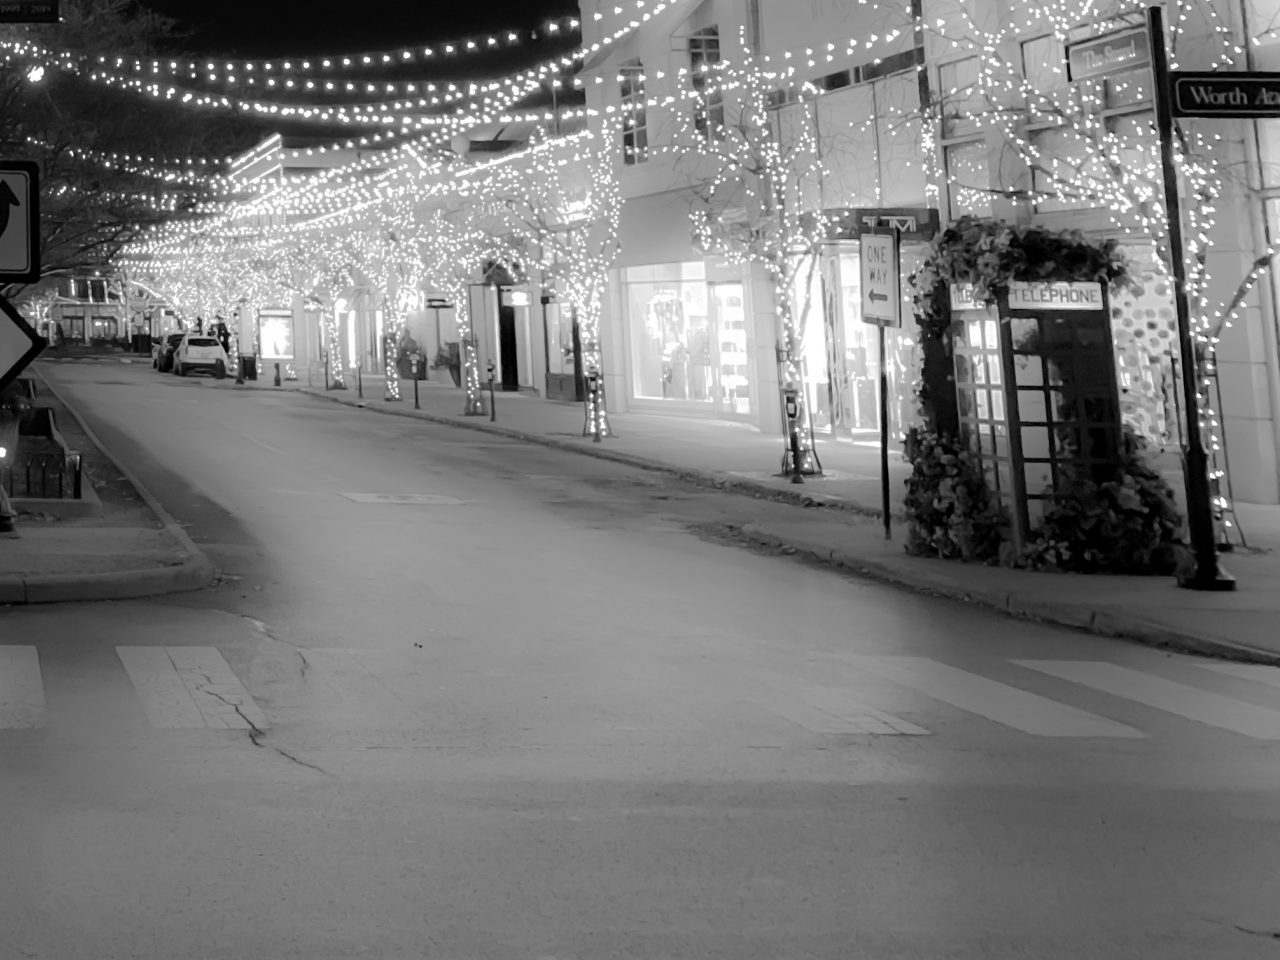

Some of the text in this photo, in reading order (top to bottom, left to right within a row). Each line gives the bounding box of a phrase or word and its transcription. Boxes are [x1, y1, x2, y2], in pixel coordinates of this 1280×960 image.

[1189, 86, 1248, 105] Worth
[868, 245, 887, 263] ONE
[869, 267, 888, 286] WAY
[1010, 288, 1099, 303] TELEPHONE
